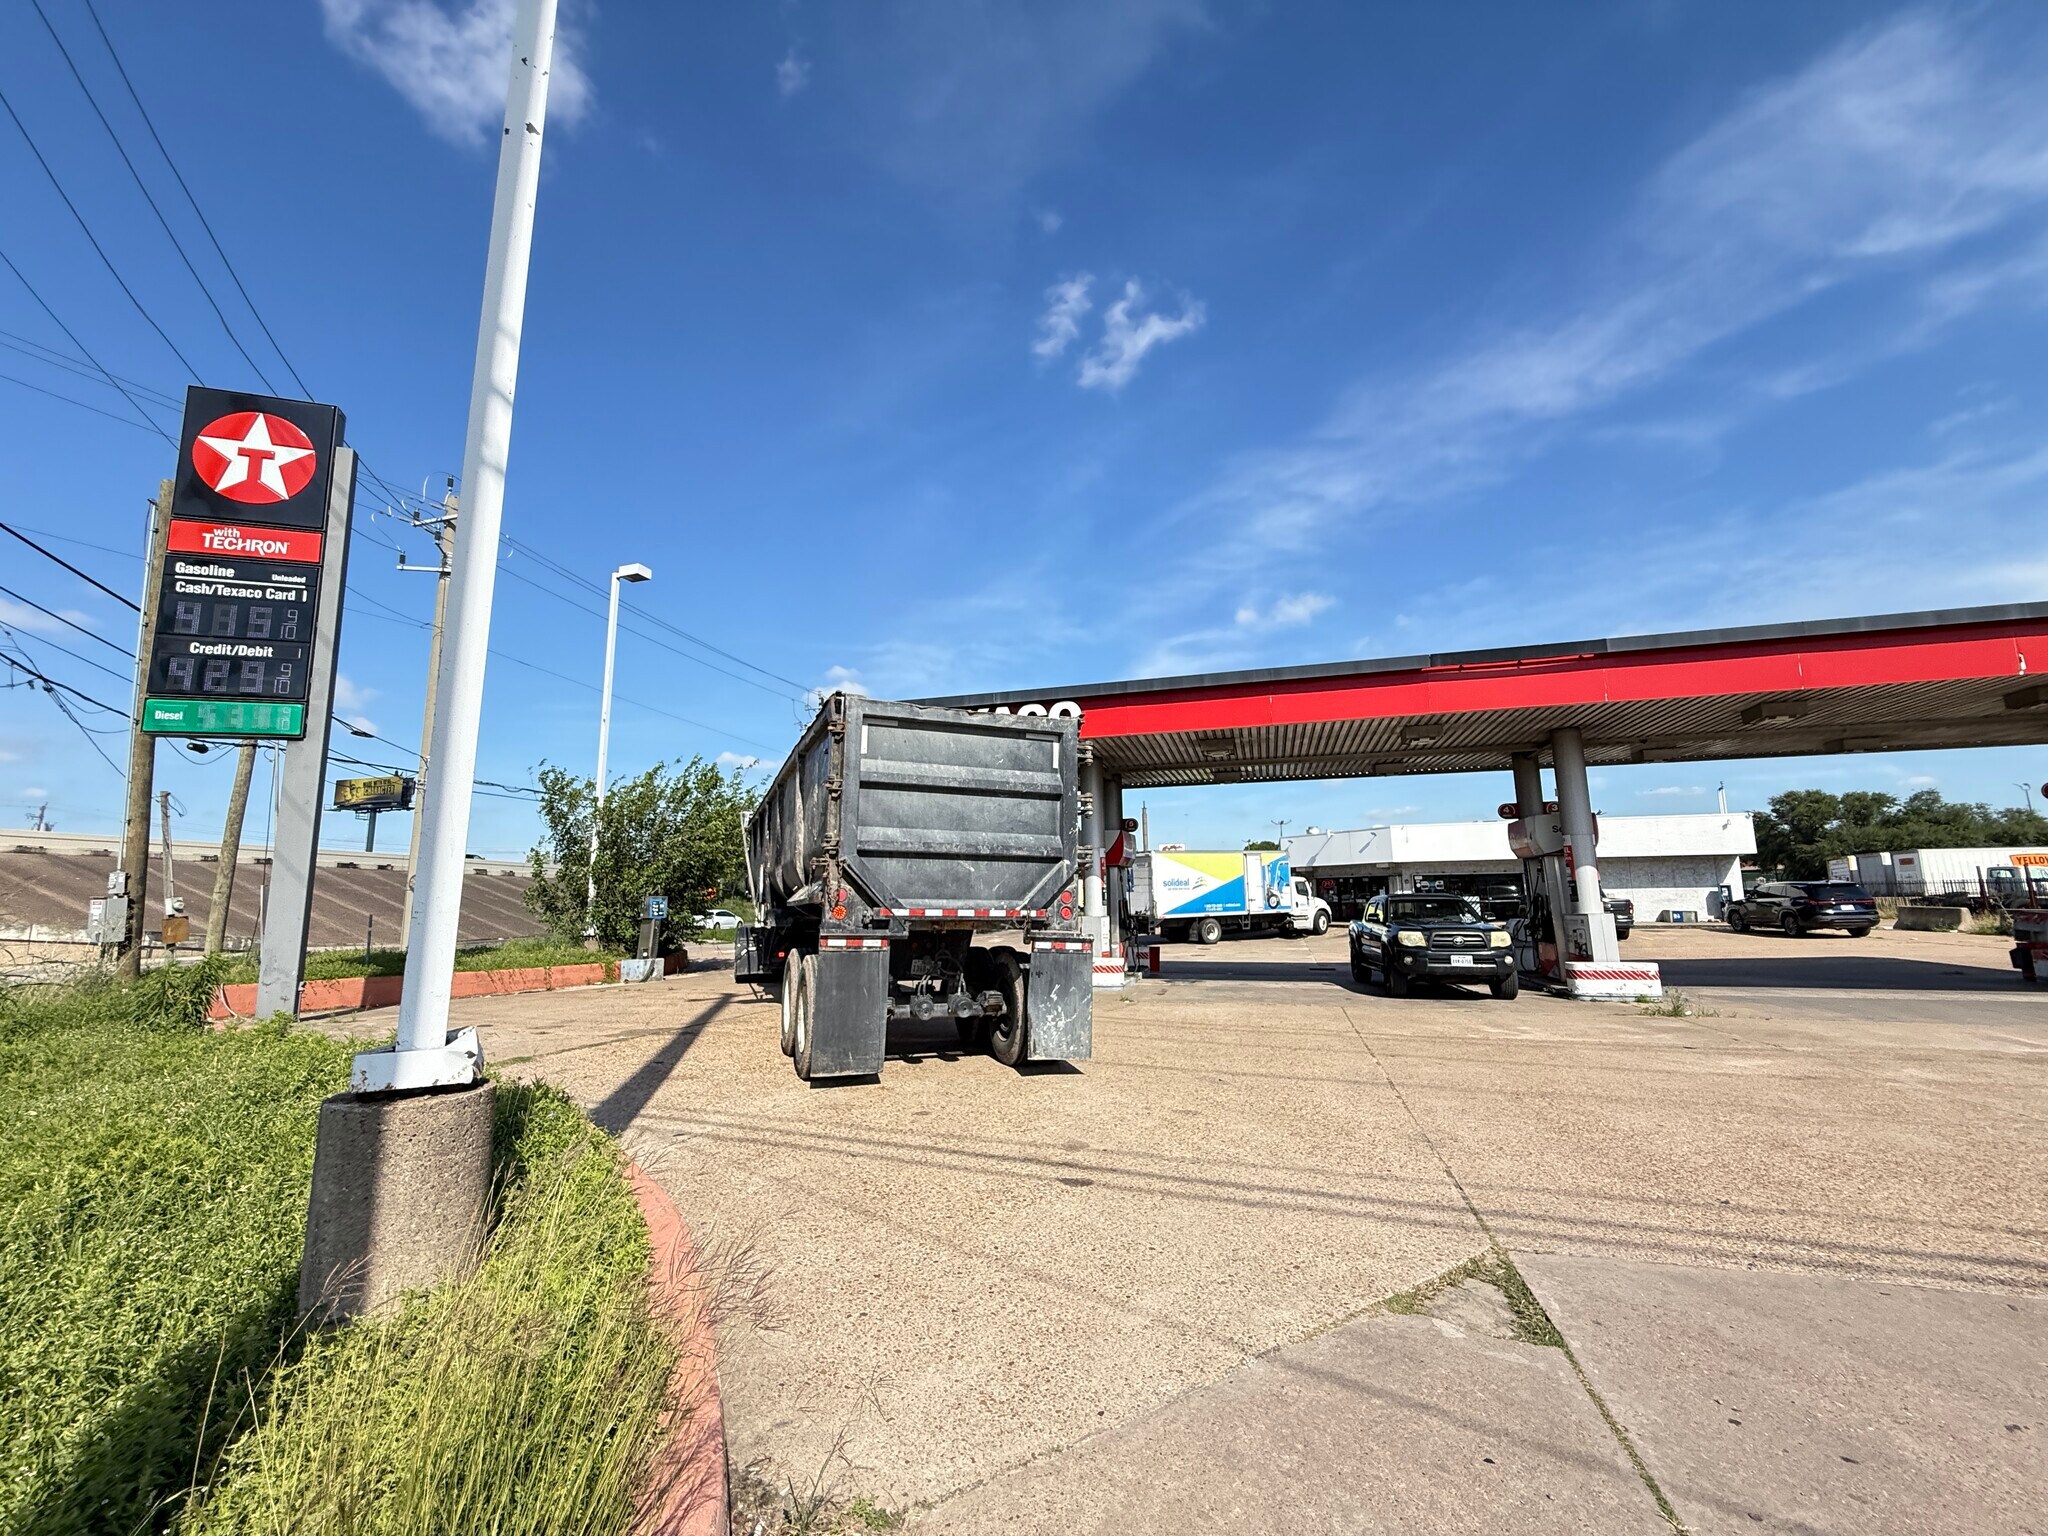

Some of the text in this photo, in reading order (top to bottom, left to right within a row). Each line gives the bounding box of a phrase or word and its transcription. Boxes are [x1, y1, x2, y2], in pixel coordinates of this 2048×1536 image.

[238, 446, 275, 482] T
[213, 527, 240, 538] with
[202, 532, 288, 556] TECHRON
[175, 561, 235, 578] Gasoline
[271, 574, 306, 583] Unleaded
[175, 581, 296, 601] Cash/Texaco Card
[189, 642, 274, 658] Credit/Debit
[154, 710, 184, 720] Diesel
[1163, 878, 1190, 887] solideal
